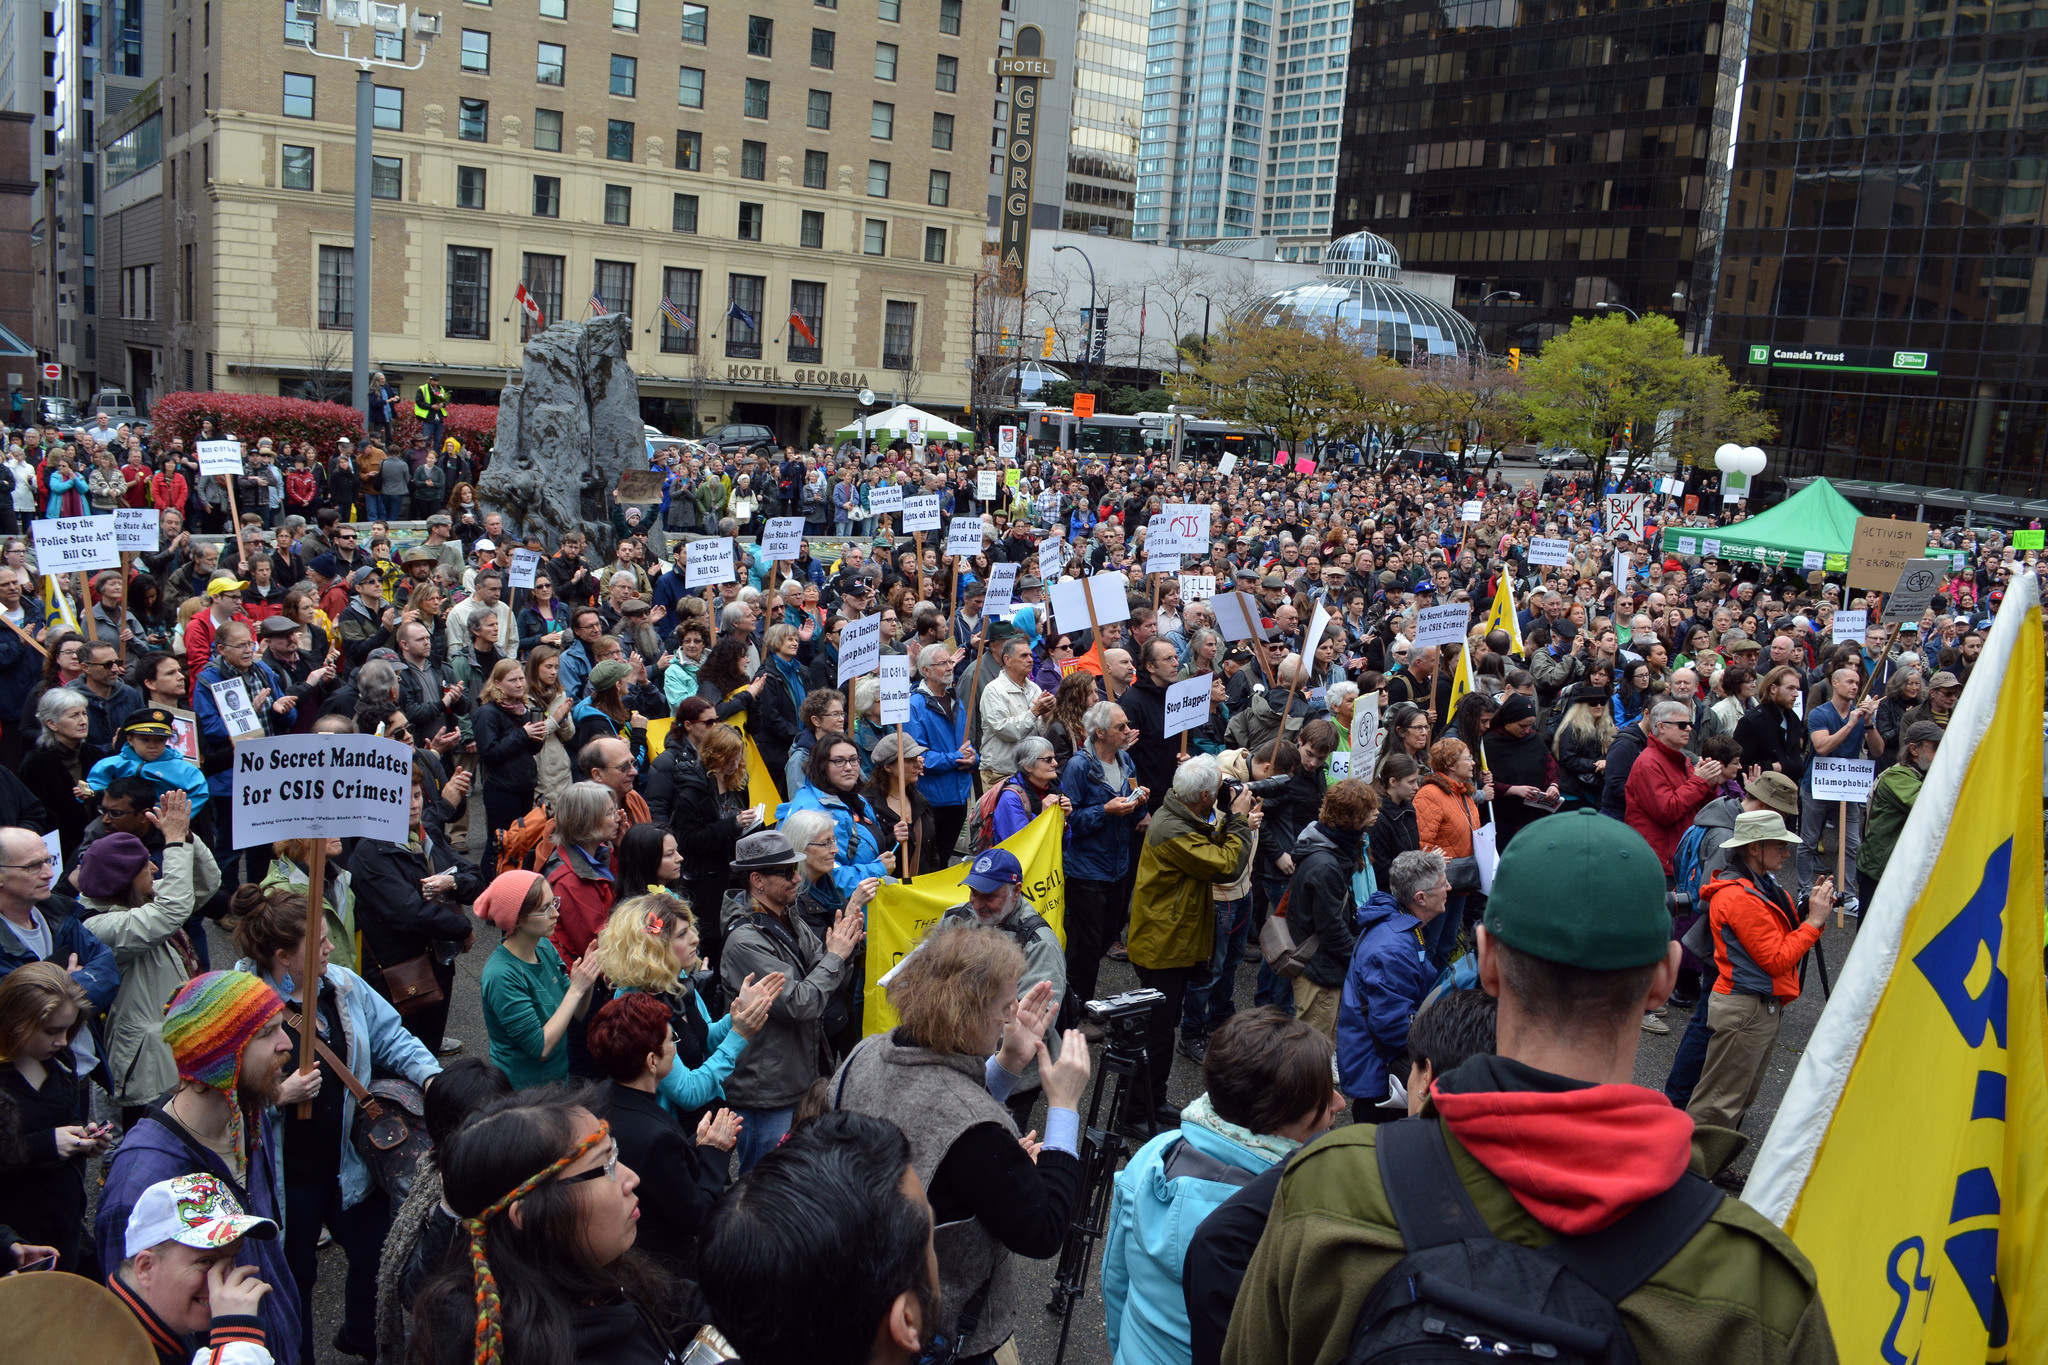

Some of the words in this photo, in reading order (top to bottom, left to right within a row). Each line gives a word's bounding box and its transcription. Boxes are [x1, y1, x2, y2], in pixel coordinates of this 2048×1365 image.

[1003, 60, 1050, 75] HOTEL
[1003, 85, 1034, 269] GEORGIA
[1752, 348, 1767, 360] TD
[1773, 349, 1813, 360] Canada
[1814, 351, 1845, 362] Trust
[727, 364, 780, 380] HOTEL
[794, 369, 869, 386] GEORGIA
[870, 498, 885, 506] Rights
[904, 499, 923, 509] Defend
[925, 498, 937, 506] the
[1611, 498, 1634, 514] Bill
[131, 510, 142, 518] the
[56, 521, 77, 531] Stop
[79, 519, 94, 528] the
[123, 522, 140, 530] State
[783, 519, 792, 527] the
[968, 521, 981, 529] the
[1611, 515, 1637, 531] C-51
[116, 533, 127, 541] Bill
[128, 533, 140, 541] C51
[960, 533, 968, 542] of
[1862, 527, 1913, 539] ACTIVISM
[71, 534, 94, 544] State
[695, 543, 709, 551] Stop
[1722, 544, 1752, 556] green
[62, 549, 79, 559] Bill
[81, 548, 97, 558] C51
[702, 554, 718, 562] State
[1530, 550, 1567, 558] Islamophobia!
[1857, 558, 1906, 570] TERRORIS
[697, 566, 709, 575] Bill
[709, 566, 719, 574] C51
[997, 570, 1015, 580] Incites
[1183, 577, 1212, 590] KILL
[1910, 575, 1931, 586] C-51
[1419, 613, 1427, 621] No
[1427, 611, 1443, 620] Secret
[1443, 608, 1467, 617] Mandates
[845, 629, 857, 641] C-51
[858, 622, 879, 637] Incites
[1418, 625, 1428, 633] for
[1428, 622, 1442, 631] CSIS
[1443, 620, 1465, 629] Crimes!
[881, 667, 889, 678] Bill
[889, 667, 901, 678] C-51
[892, 692, 898, 700] on
[1166, 702, 1181, 714] Stop
[236, 718, 250, 732] YOU
[240, 752, 264, 773] No
[269, 749, 325, 769] Secret
[330, 747, 408, 775] Mandates
[1814, 762, 1828, 771] Bill
[1829, 763, 1846, 772] C-51
[1848, 764, 1873, 773] Incites
[1814, 777, 1872, 788] Islamophobia!
[243, 785, 271, 806] for
[280, 780, 324, 800] CSIS
[333, 779, 403, 805] Crimes!
[251, 819, 275, 827] Working
[914, 917, 937, 930] THE
